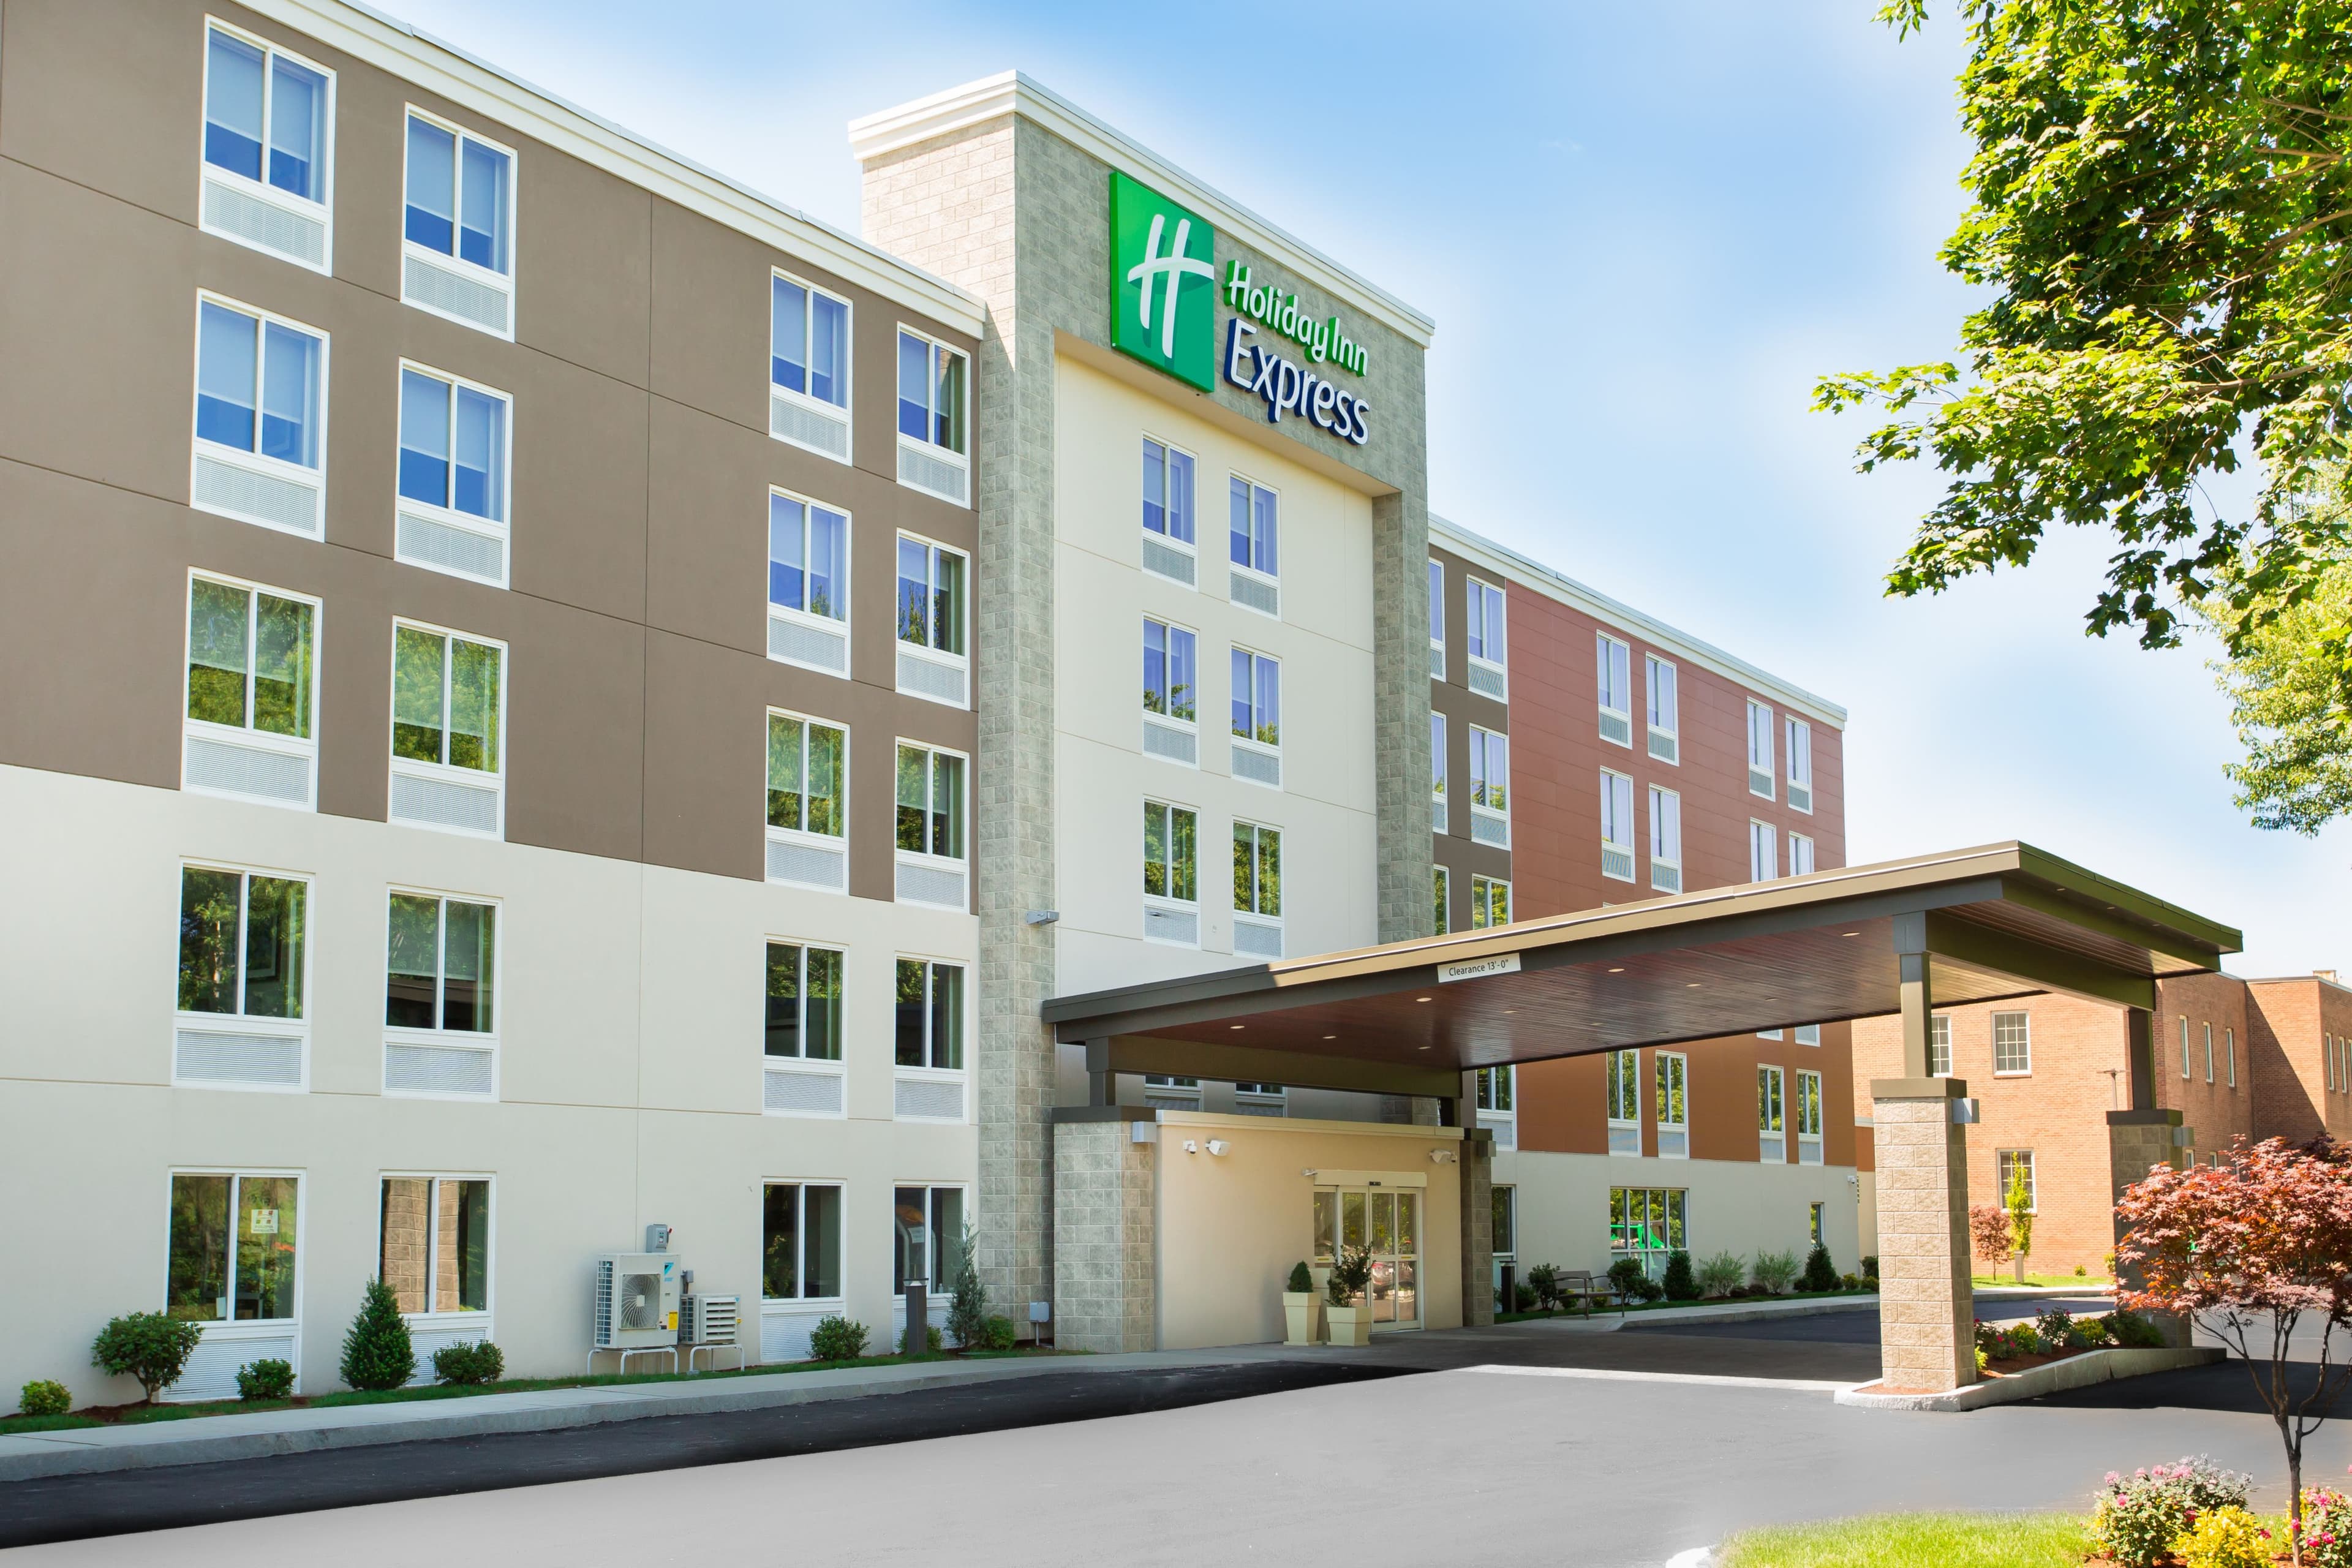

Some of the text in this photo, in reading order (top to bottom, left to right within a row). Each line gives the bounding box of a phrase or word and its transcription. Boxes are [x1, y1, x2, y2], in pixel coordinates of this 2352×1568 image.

[1223, 260, 1368, 377] Holiday Inn
[1224, 318, 1370, 445] Express
[1449, 964, 1485, 976] Clearance
